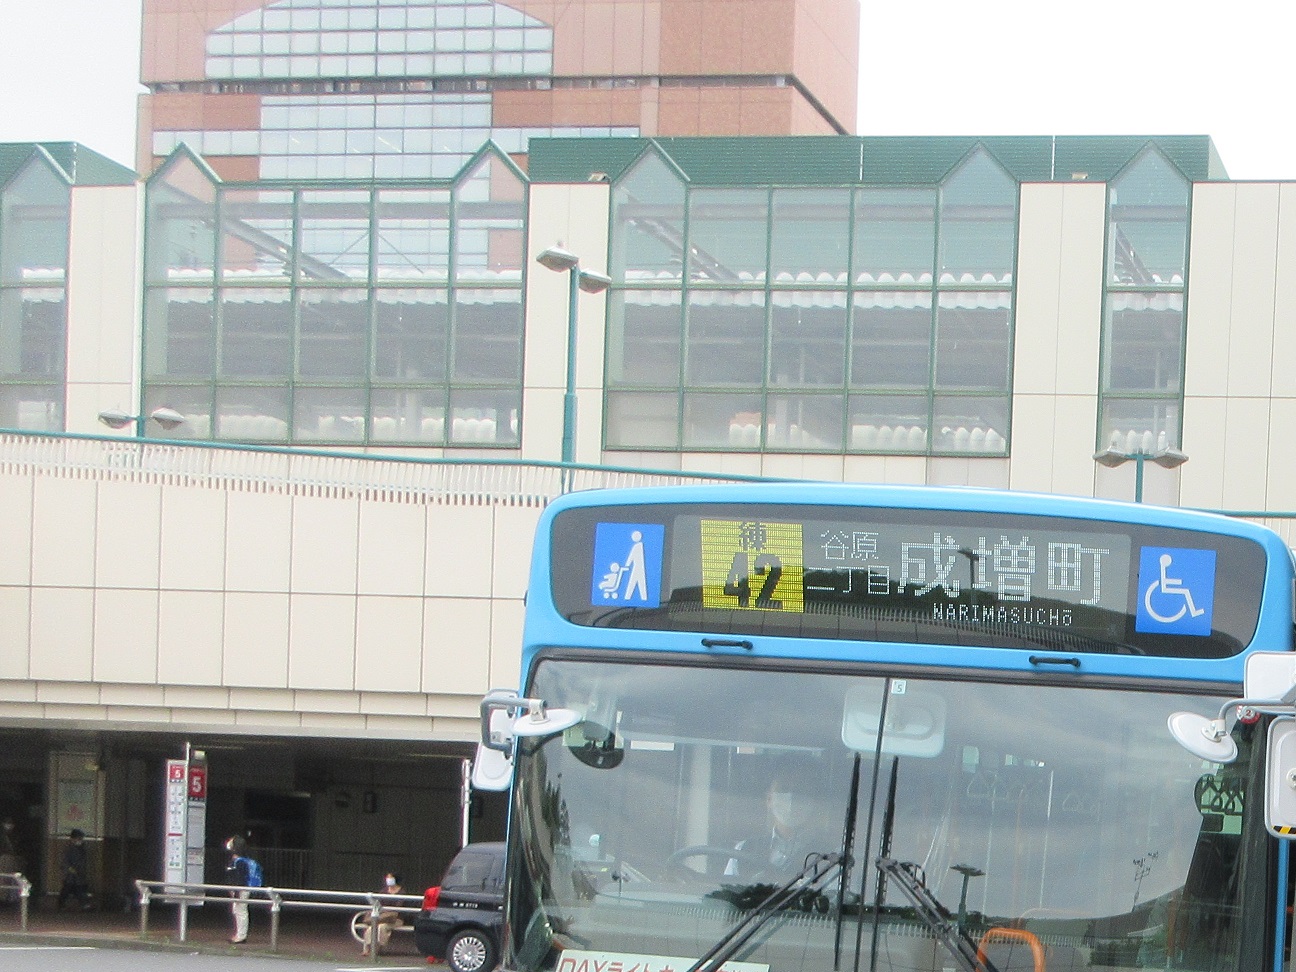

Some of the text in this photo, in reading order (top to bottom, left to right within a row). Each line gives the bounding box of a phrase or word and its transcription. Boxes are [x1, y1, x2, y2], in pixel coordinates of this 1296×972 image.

[820, 530, 880, 561] 谷原
[723, 551, 784, 610] 42
[806, 565, 890, 595] 二丁目
[897, 532, 1110, 605] 成増町
[193, 777, 202, 793] 5
